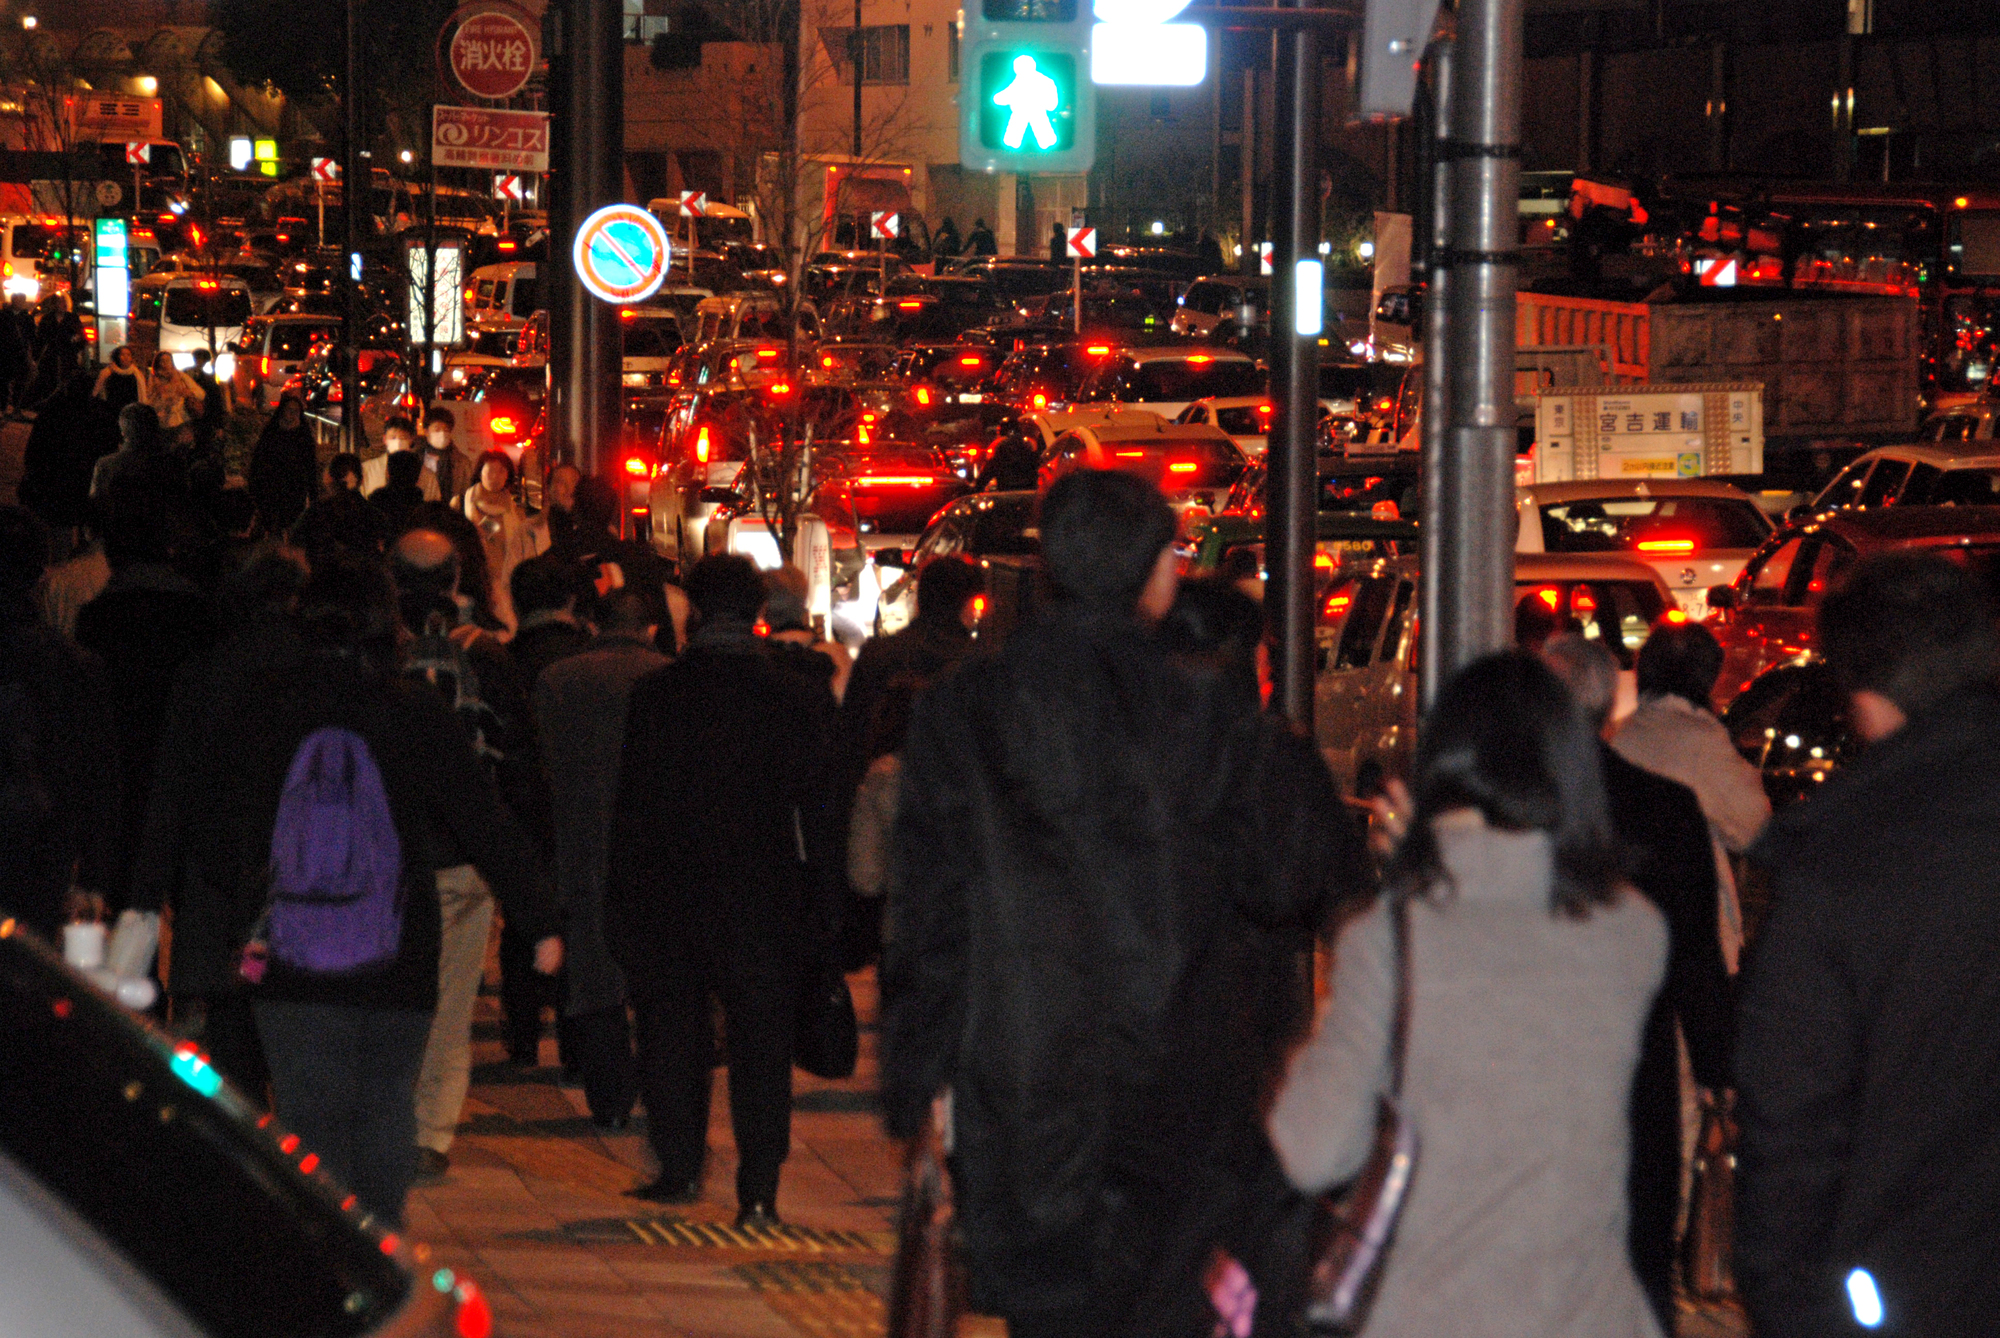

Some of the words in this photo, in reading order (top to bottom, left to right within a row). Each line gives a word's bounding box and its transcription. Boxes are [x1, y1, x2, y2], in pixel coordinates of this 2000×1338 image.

[460, 39, 526, 71] 消火栓
[473, 125, 542, 150] リンコス
[1554, 404, 1565, 428] 東京
[1733, 400, 1744, 424] 中央
